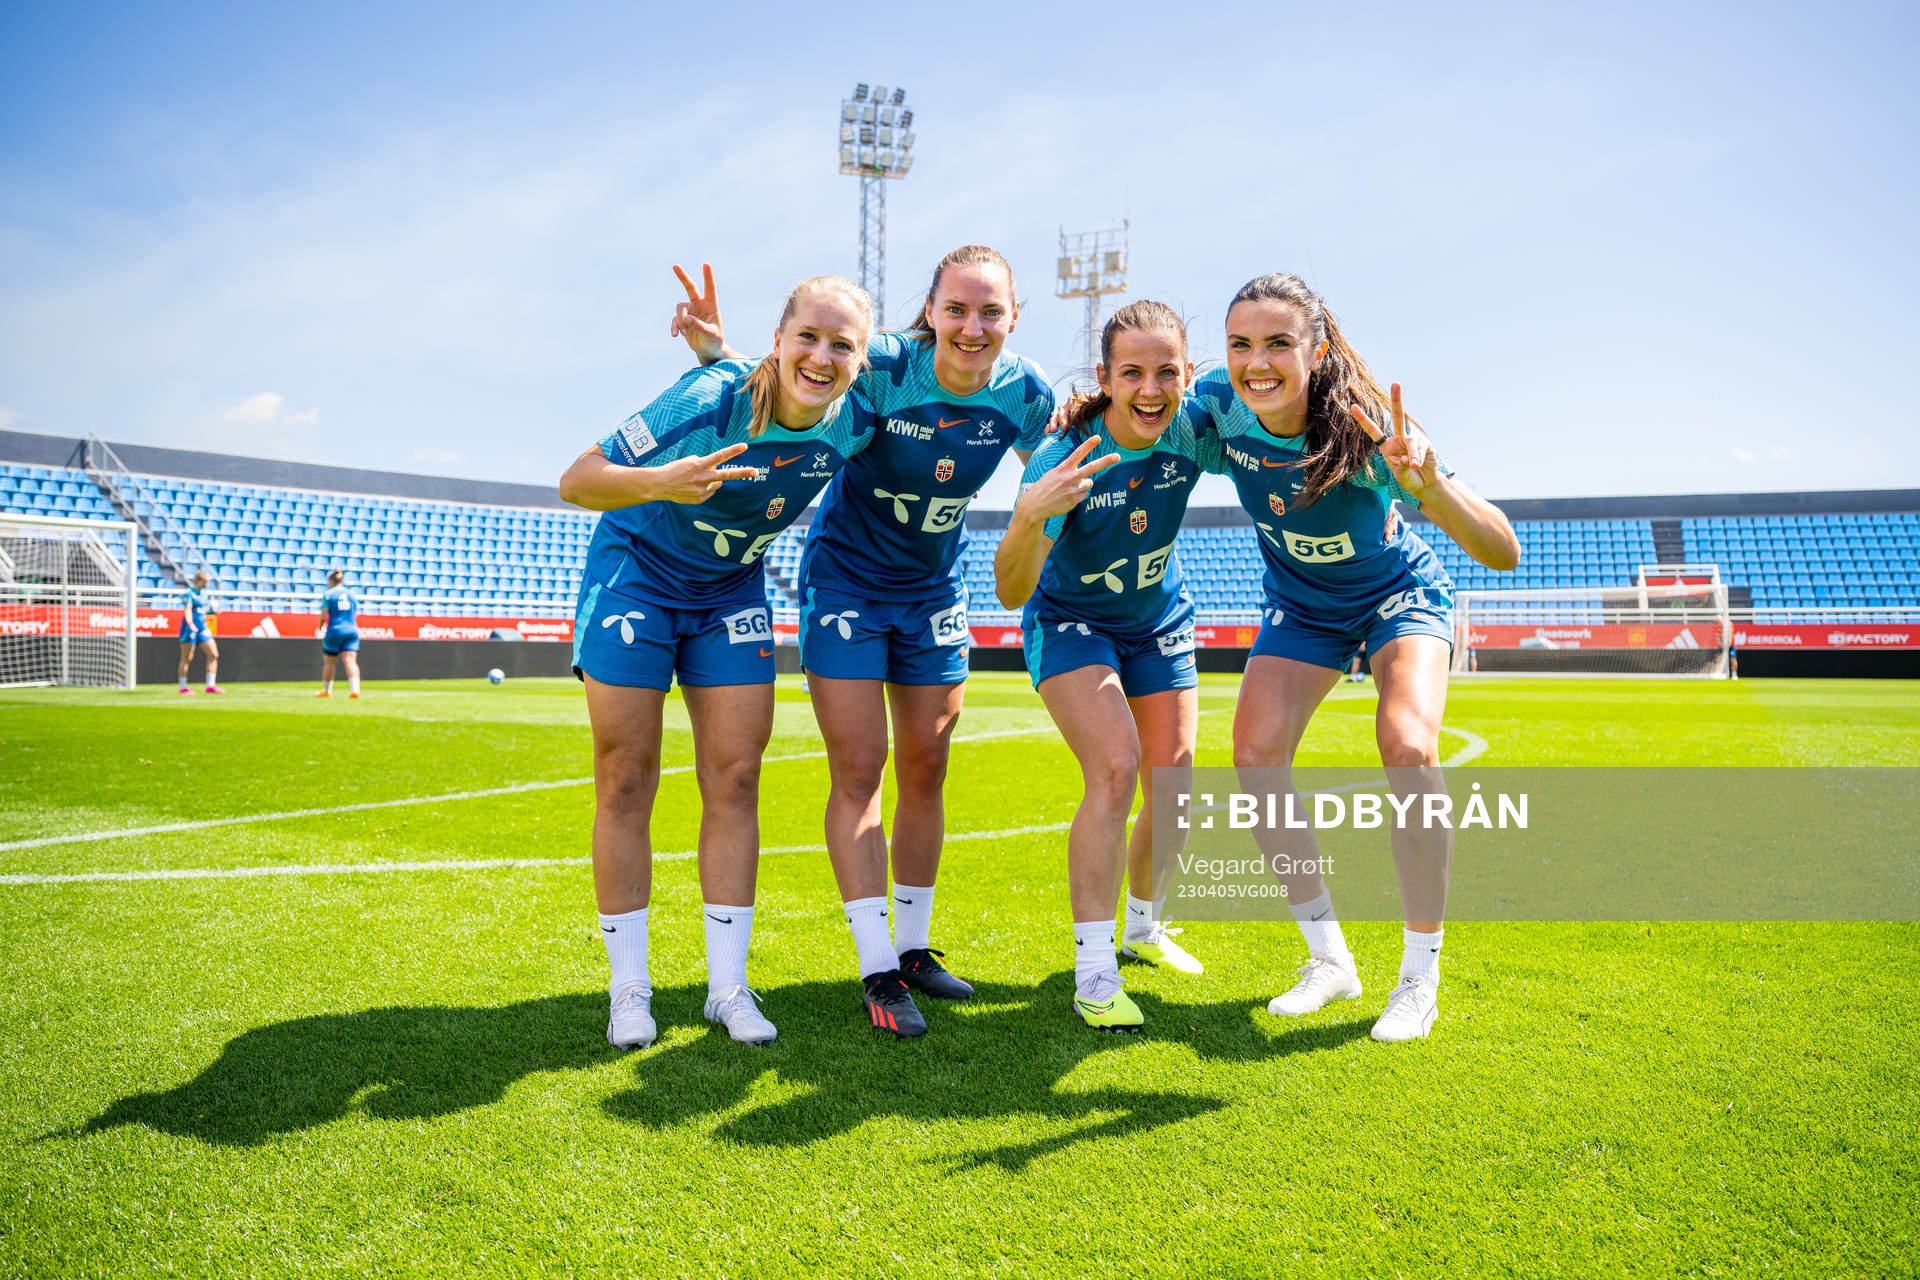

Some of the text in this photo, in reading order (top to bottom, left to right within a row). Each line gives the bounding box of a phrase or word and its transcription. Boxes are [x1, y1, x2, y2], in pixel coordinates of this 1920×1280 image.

[625, 420, 649, 449] DNB
[886, 418, 919, 437] KIWI
[920, 426, 934, 434] mini
[1112, 490, 1127, 499] mini
[1153, 482, 1170, 490] Norsk
[1113, 499, 1126, 507] pris
[1294, 540, 1344, 557] 5G
[1144, 552, 1170, 580] 5
[734, 614, 767, 636] 5G
[939, 611, 966, 637] 5G
